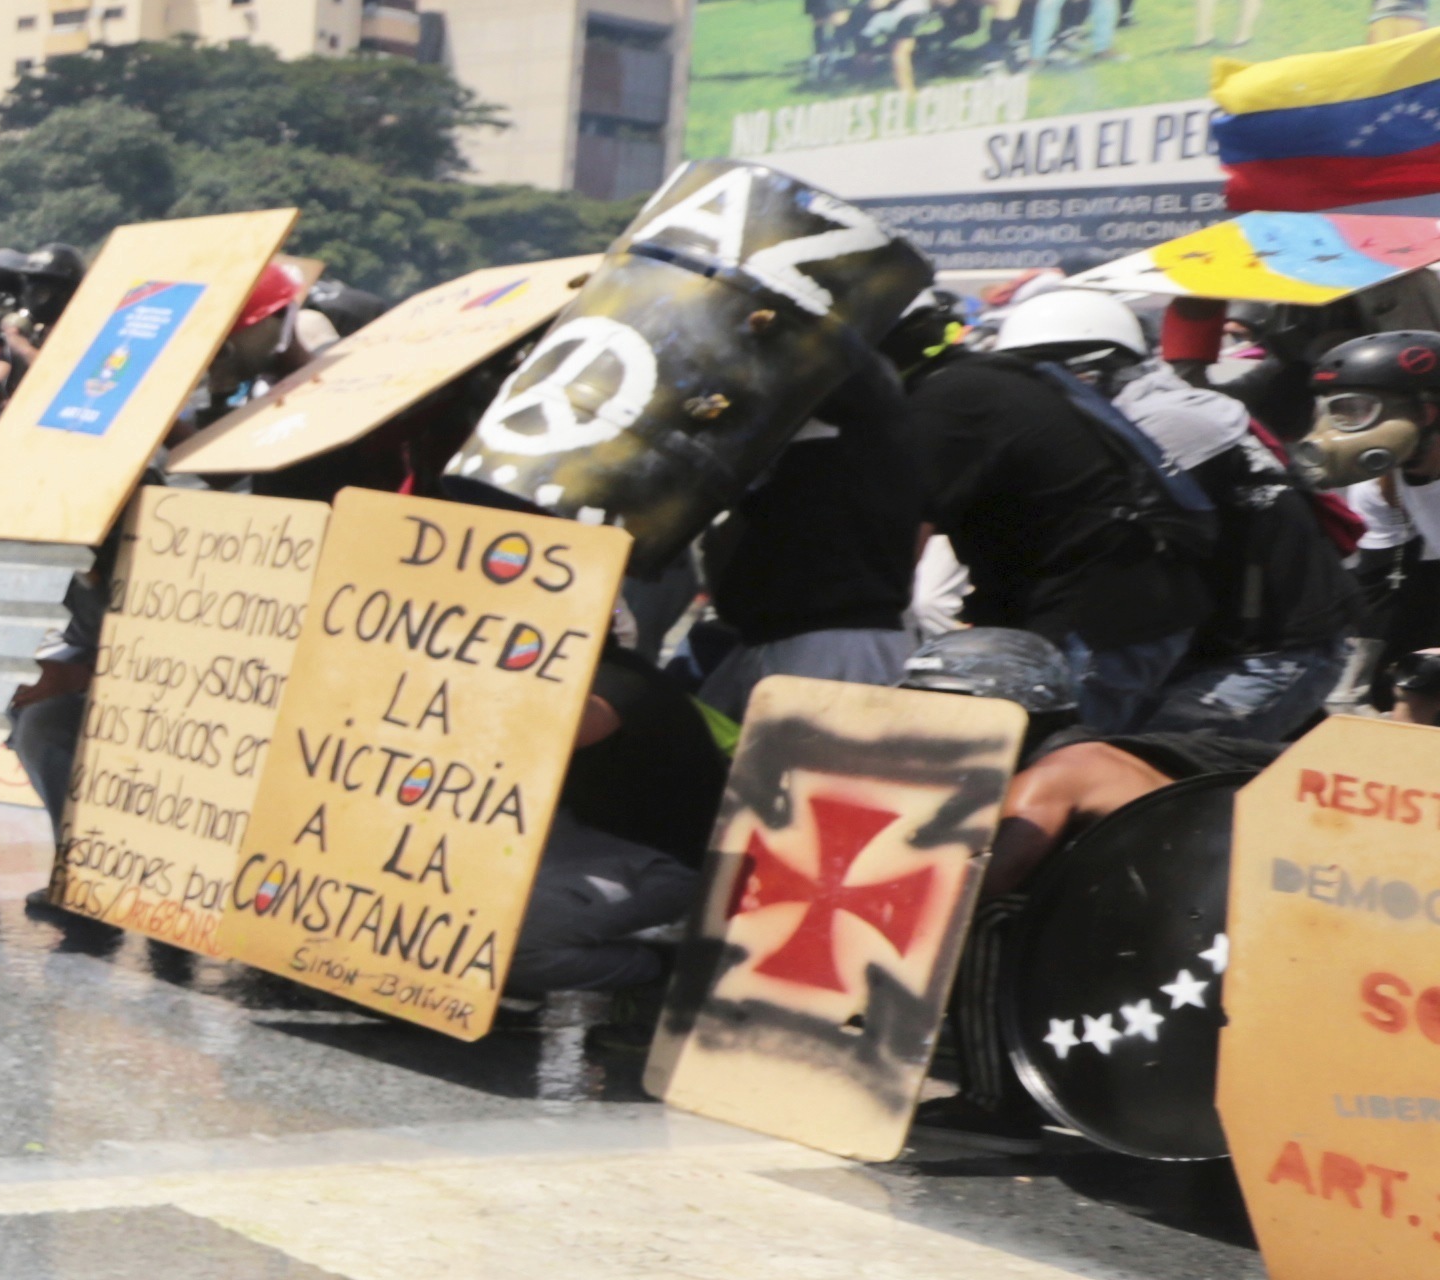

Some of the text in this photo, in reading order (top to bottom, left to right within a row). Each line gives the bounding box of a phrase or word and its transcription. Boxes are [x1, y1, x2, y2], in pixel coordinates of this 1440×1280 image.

[731, 110, 770, 157] NO
[880, 90, 910, 138] EL
[982, 125, 1082, 181] SACA
[1096, 119, 1134, 169] EL
[1062, 193, 1150, 217] EVITAR
[1153, 193, 1187, 215] EL
[148, 493, 190, 557] Se
[190, 514, 315, 579] prohibe
[400, 516, 575, 593] DIOS
[176, 573, 218, 628] de
[322, 583, 589, 685] CONCEDE
[126, 636, 187, 703] fuego
[382, 671, 450, 735] LA
[294, 802, 451, 894] A LA
